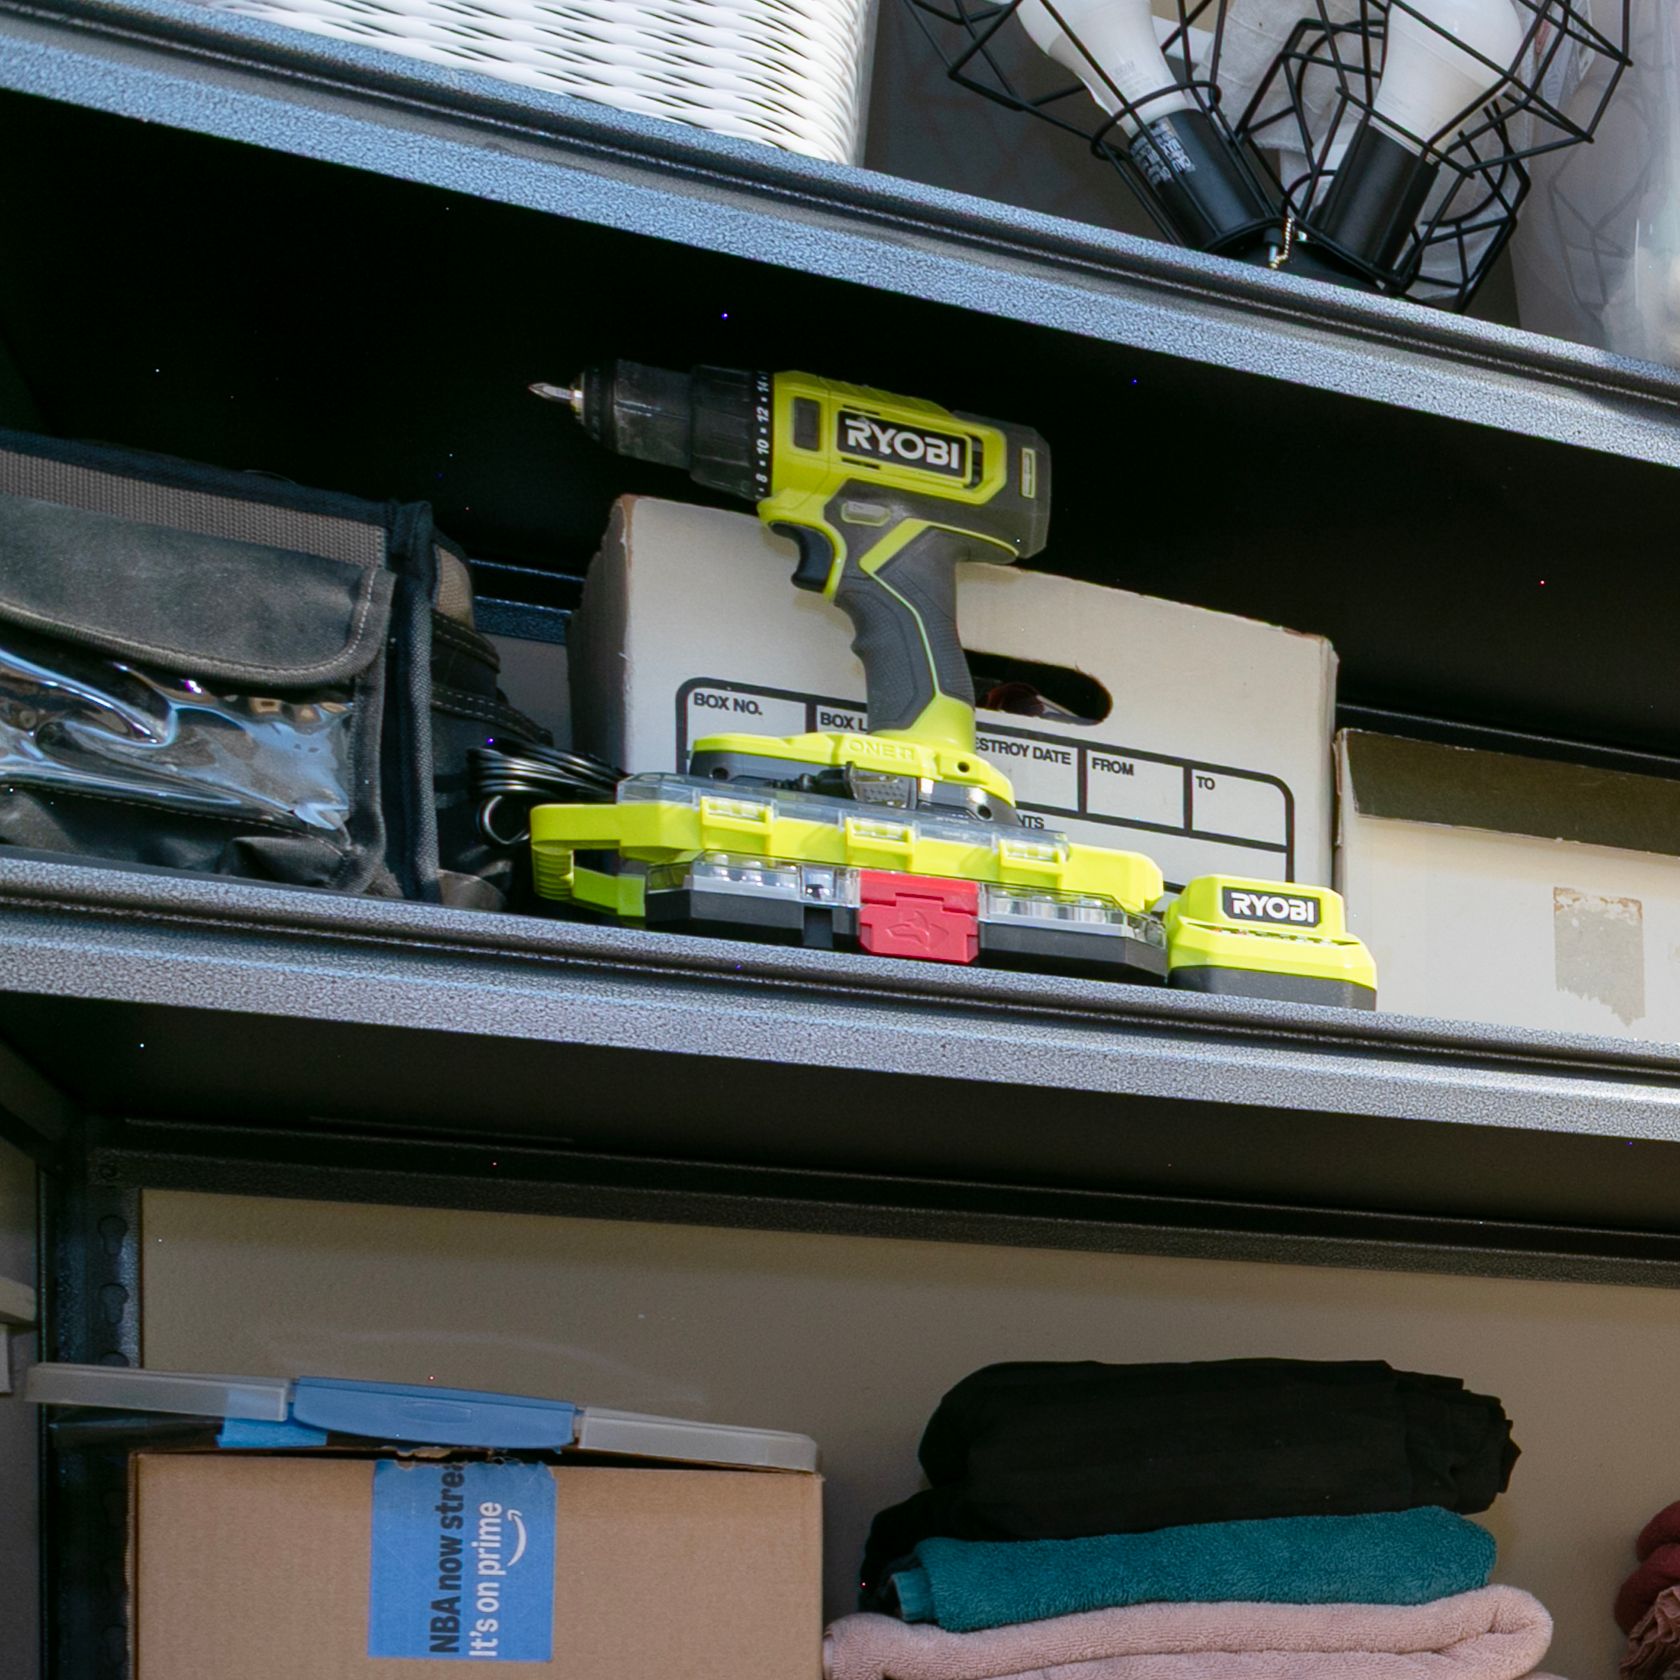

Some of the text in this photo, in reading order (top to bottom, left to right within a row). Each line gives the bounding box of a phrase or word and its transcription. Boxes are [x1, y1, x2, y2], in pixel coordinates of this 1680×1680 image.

[756, 406, 770, 423] 12
[756, 438, 770, 455] 10
[844, 416, 960, 470] RYOBI
[693, 692, 763, 716] BOX NO.
[820, 711, 855, 730] BOX
[974, 737, 1071, 765] ESTROY DATE
[1091, 758, 1134, 776] FROM
[1196, 775, 1215, 791] TO
[1230, 892, 1314, 923] RYOBI
[438, 1535, 462, 1591] now
[469, 1501, 506, 1656] It's on prime
[429, 1596, 461, 1653] NBA
